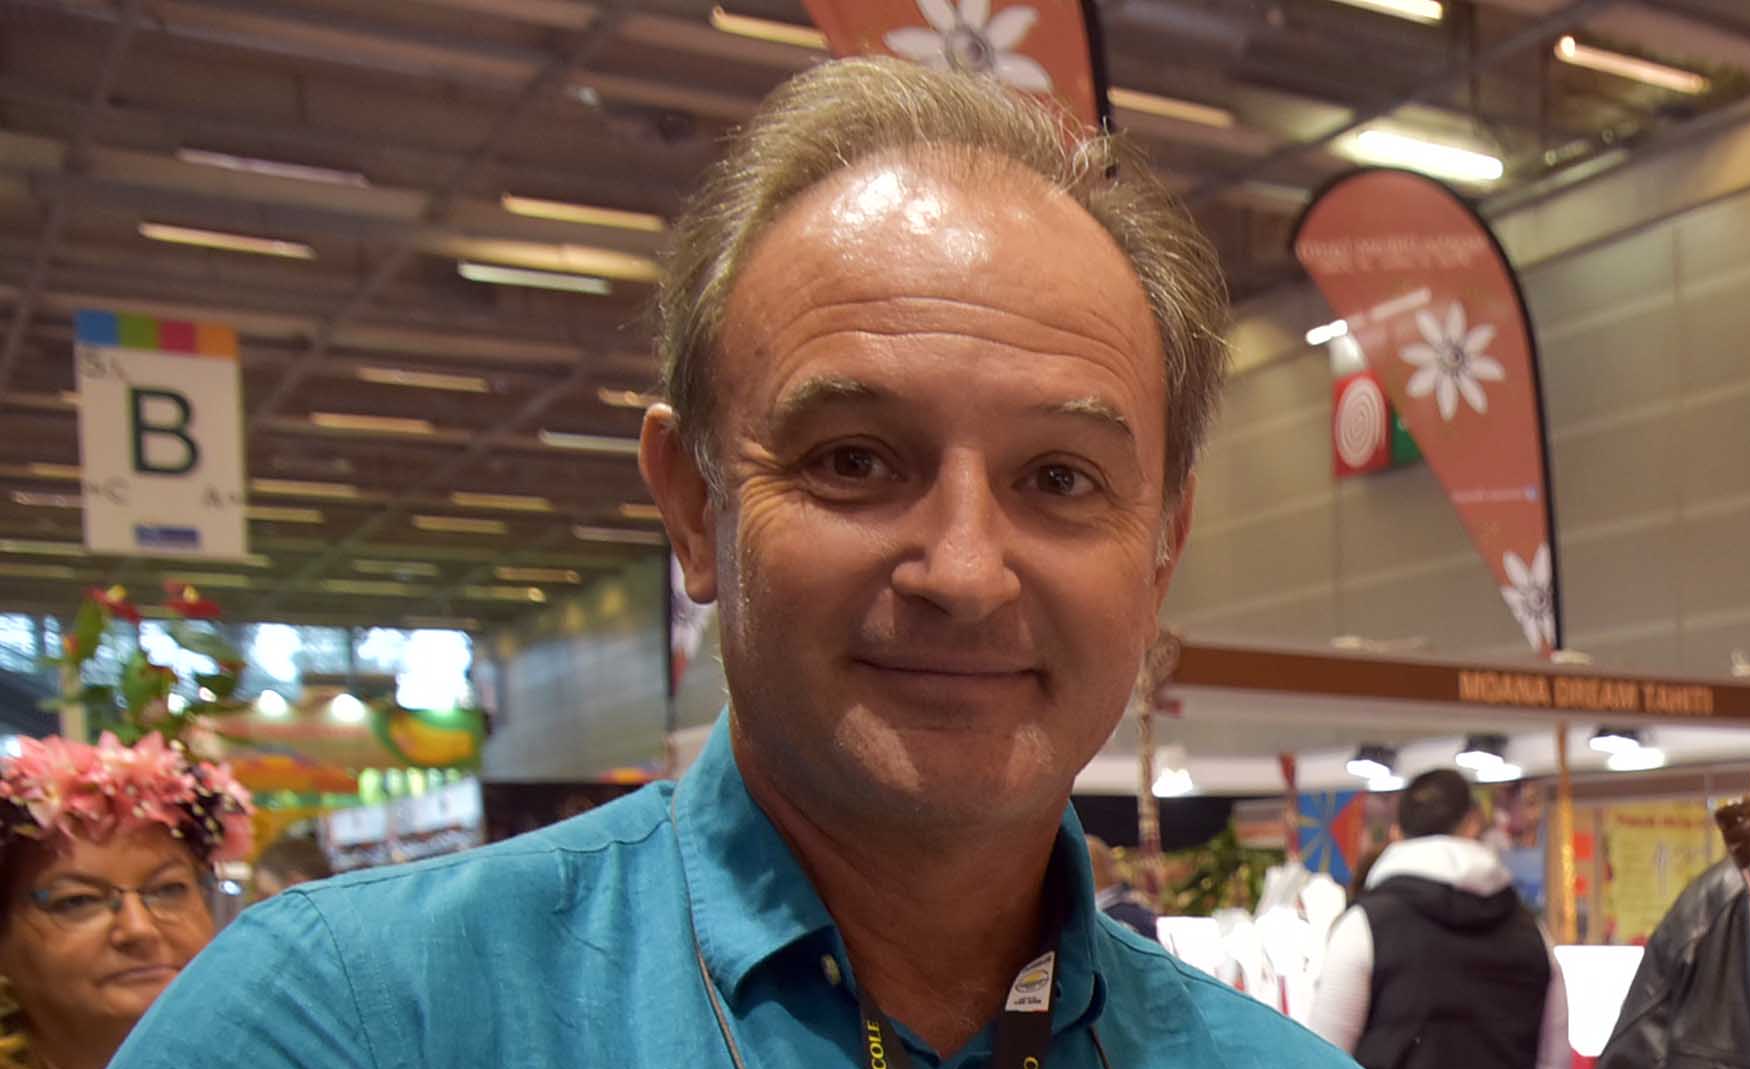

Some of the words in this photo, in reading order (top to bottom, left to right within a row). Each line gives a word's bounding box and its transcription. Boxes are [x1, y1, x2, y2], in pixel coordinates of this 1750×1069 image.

[130, 386, 200, 474] B
[1460, 671, 1551, 705] MOANA
[1554, 677, 1639, 710] DREAM
[1644, 683, 1714, 714] TAHITI
